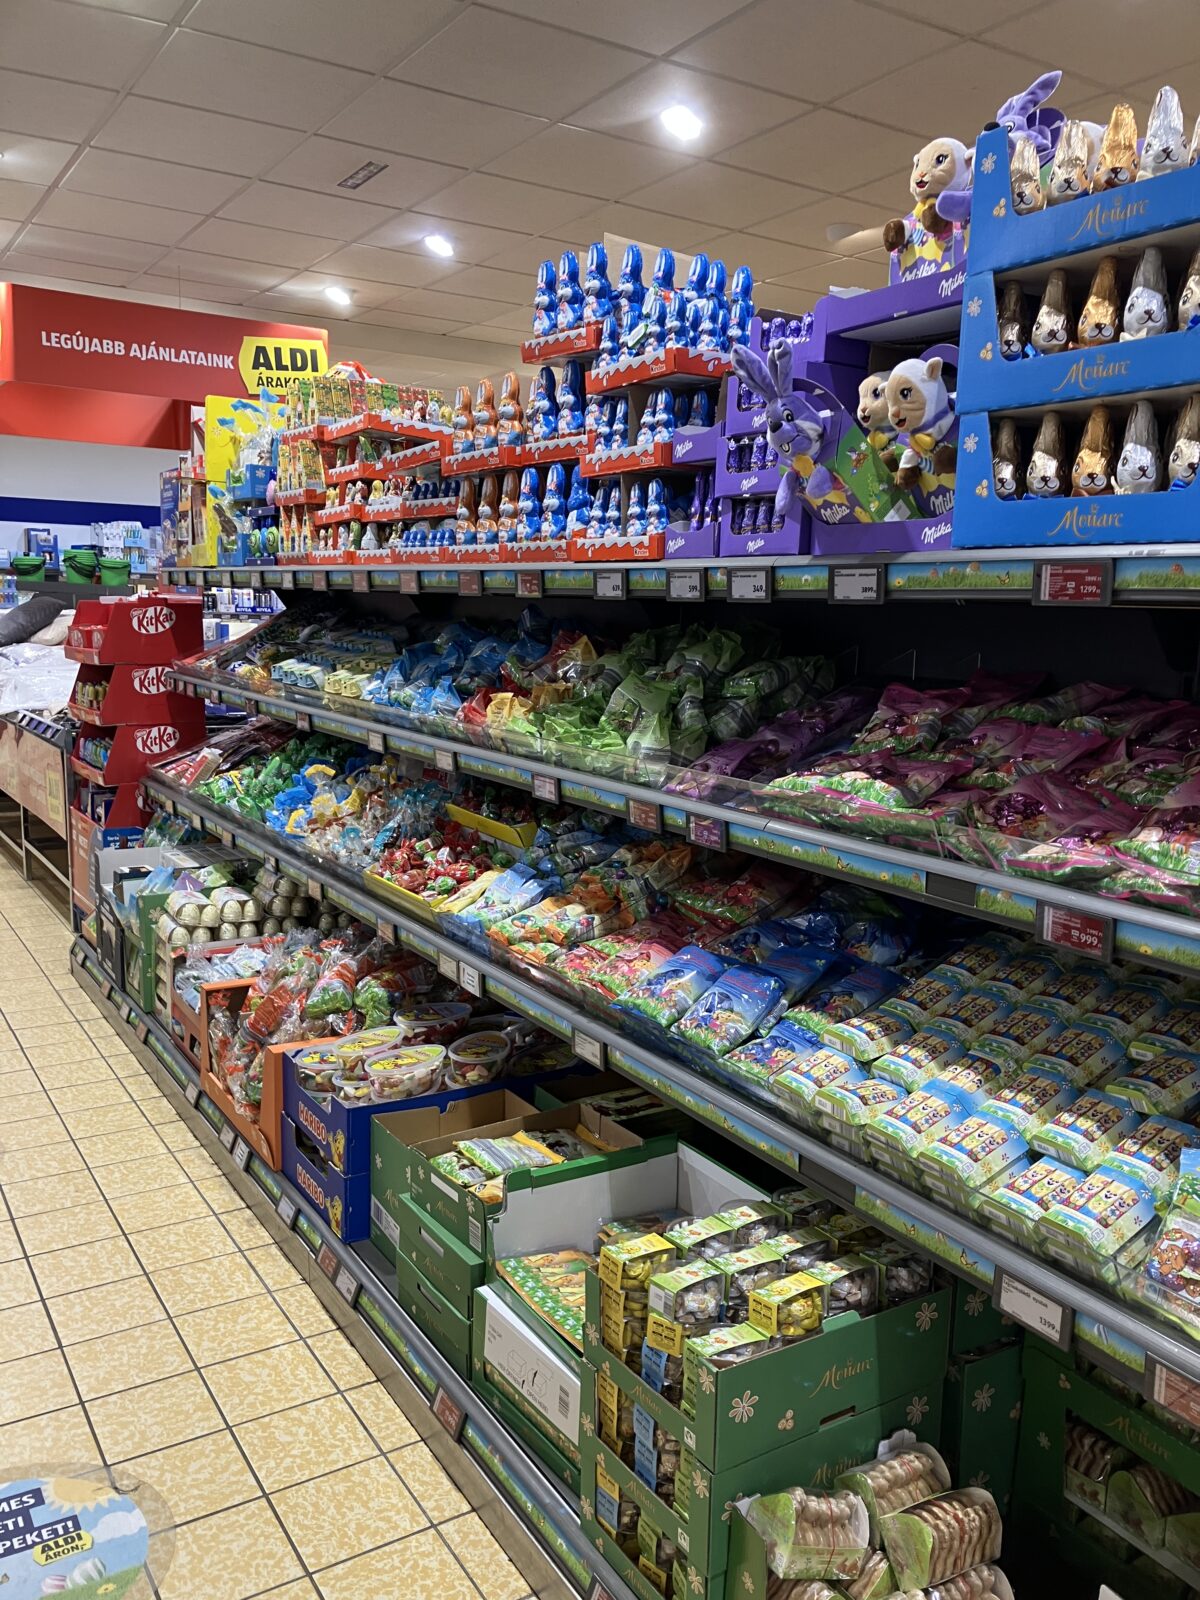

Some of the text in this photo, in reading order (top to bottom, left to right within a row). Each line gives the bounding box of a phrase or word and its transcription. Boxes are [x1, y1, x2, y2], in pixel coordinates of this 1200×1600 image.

[902, 261, 938, 282] Milka
[41, 331, 235, 370] LEGÚJABB AJÁNLATAINK
[251, 345, 319, 373] ALDI
[650, 364, 666, 373] Kinder
[675, 441, 693, 458] Milka
[640, 456, 655, 465] Kinder
[741, 475, 759, 491] Milka
[821, 504, 850, 524] Milka
[921, 522, 953, 544] Milka
[634, 548, 650, 557] Kinder
[667, 537, 685, 554] Milka
[747, 538, 765, 553] Milka
[688, 584, 698, 593] 599
[752, 584, 764, 593] 349
[1080, 585, 1097, 593] 1299
[137, 606, 174, 633] KitKat
[139, 667, 167, 694] KitK
[142, 726, 178, 753] KitKat
[1080, 933, 1098, 946] 999
[298, 1100, 328, 1145] HARIBO
[297, 1163, 325, 1209] HARIBO
[1039, 1316, 1056, 1331] 1399
[40, 1531, 84, 1556] ALDI
